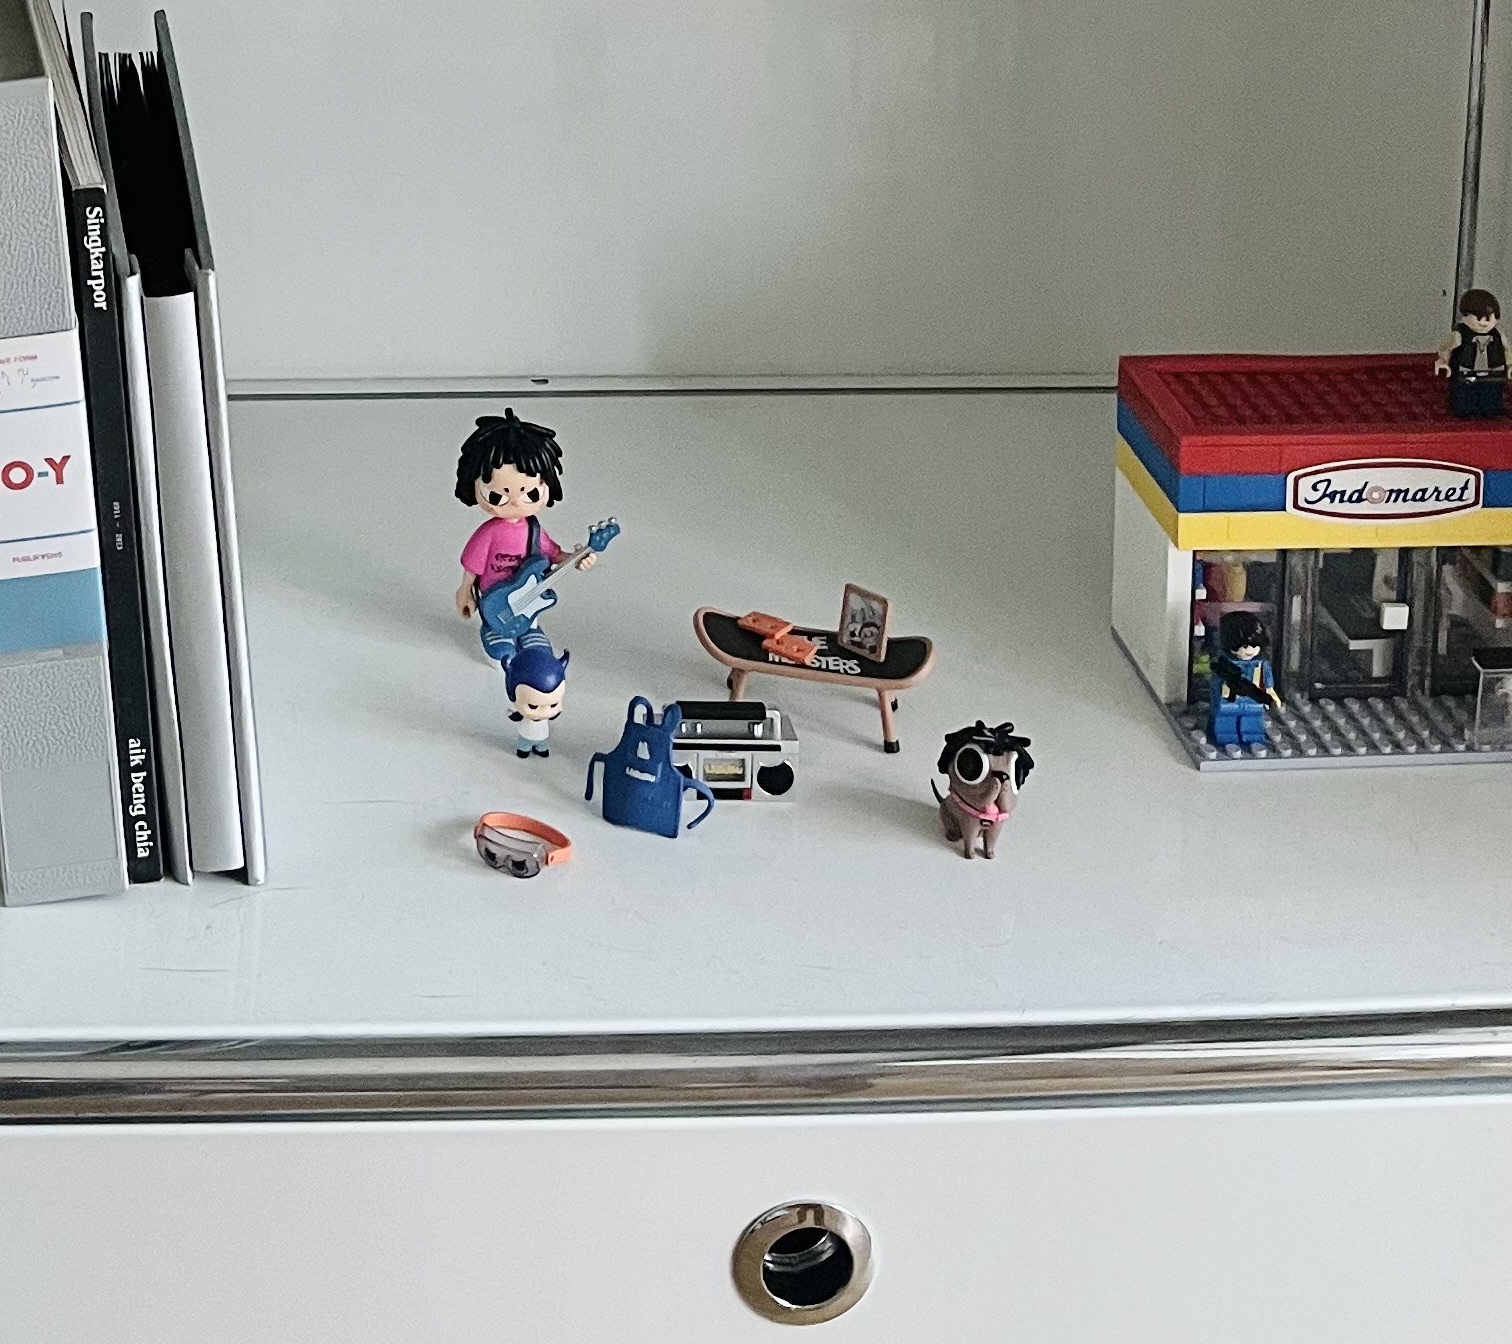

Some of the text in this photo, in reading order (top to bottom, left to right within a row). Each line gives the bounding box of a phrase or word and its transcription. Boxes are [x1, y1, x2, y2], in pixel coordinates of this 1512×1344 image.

[84, 206, 108, 311] Singkarpor
[1304, 477, 1470, 505] Indomaret
[768, 651, 861, 674] MSTERS
[128, 737, 154, 858] aik beng chia
